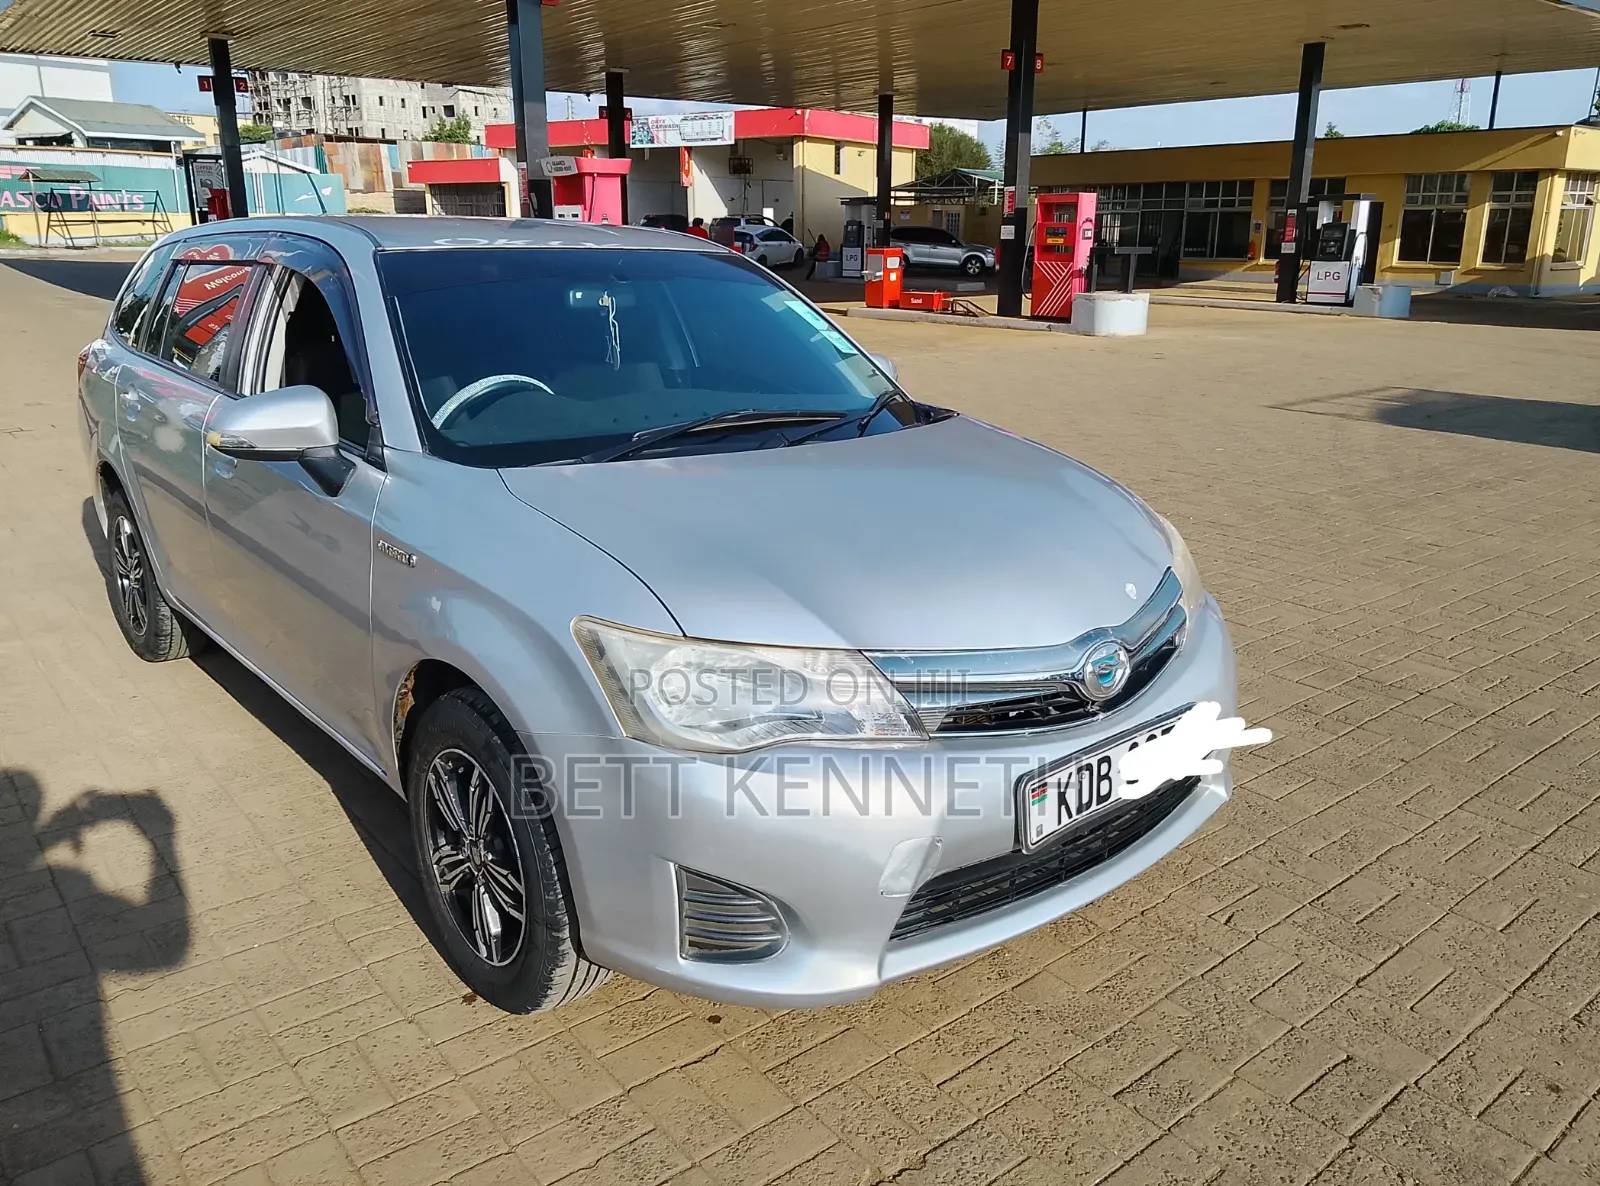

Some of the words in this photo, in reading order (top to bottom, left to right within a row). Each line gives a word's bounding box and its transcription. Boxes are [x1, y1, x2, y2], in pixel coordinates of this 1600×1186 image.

[1006, 56, 1013, 66] 7
[1036, 59, 1042, 70] 8
[203, 80, 208, 89] 1
[239, 82, 246, 90] 2
[172, 115, 195, 125] TEEL
[1316, 271, 1341, 281] LPG
[1057, 755, 1112, 826] KDB
